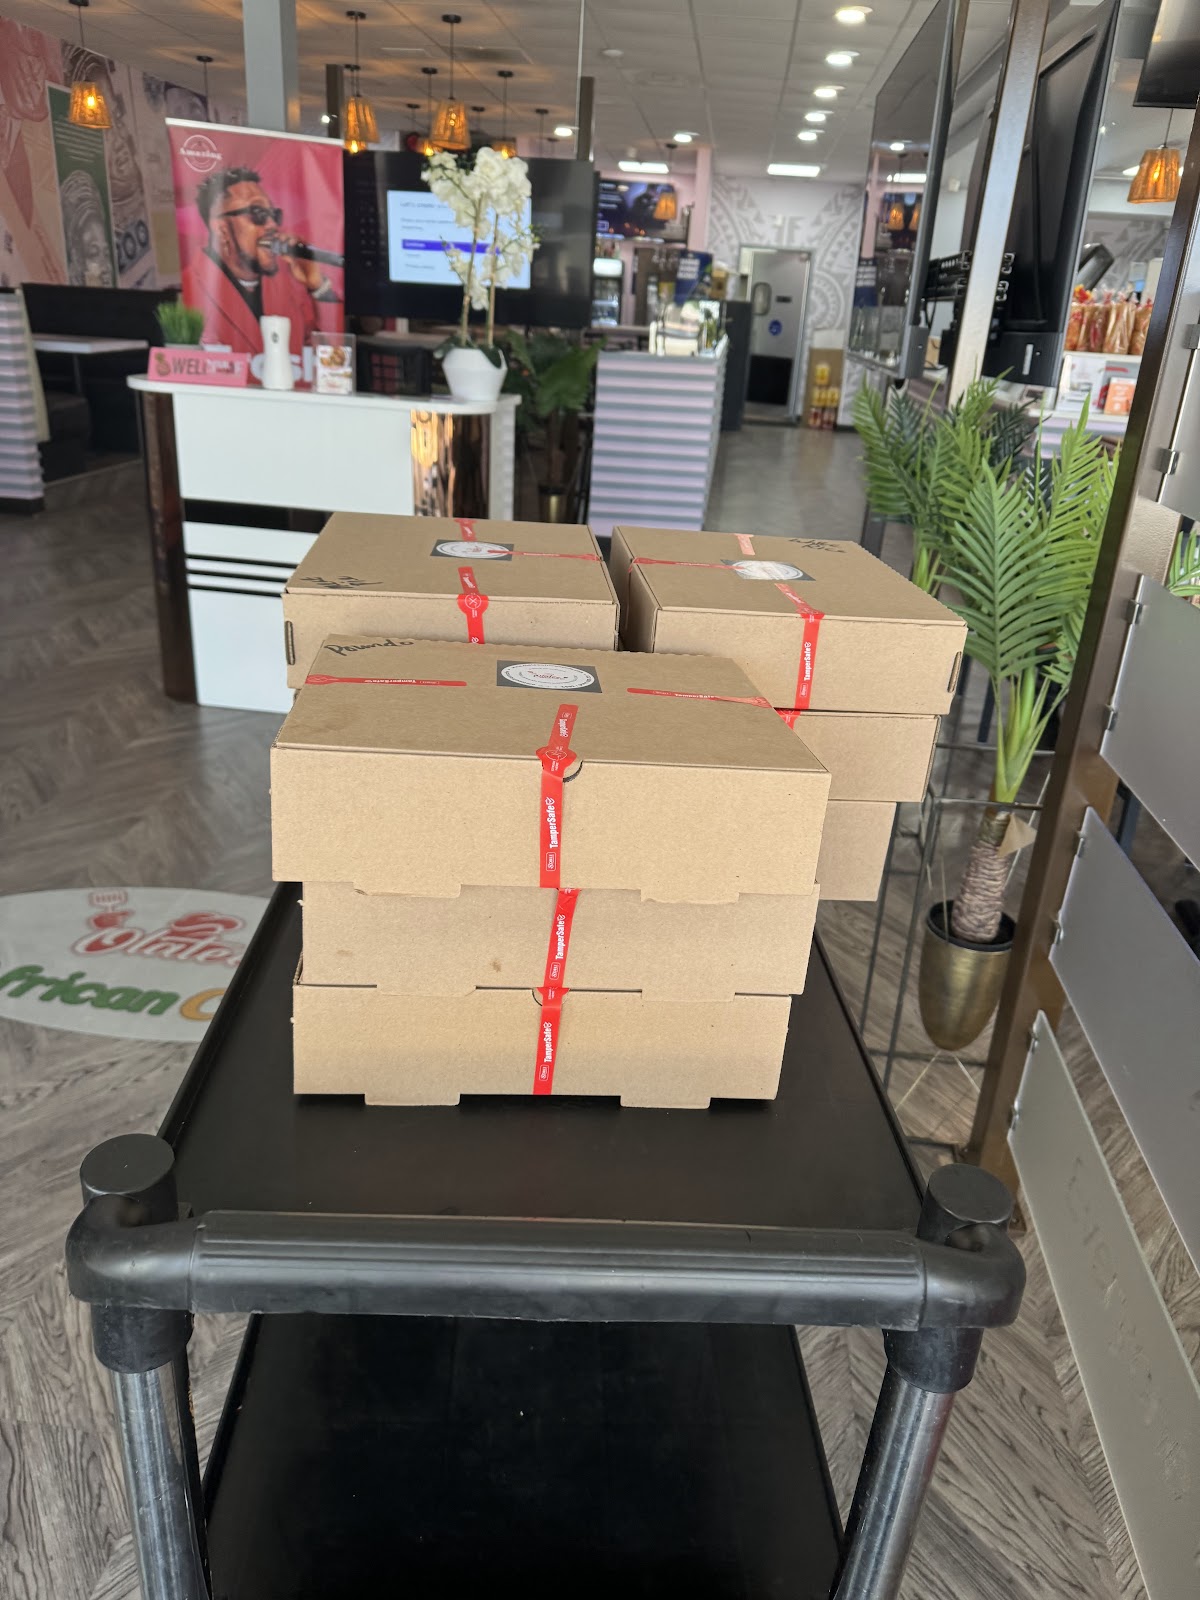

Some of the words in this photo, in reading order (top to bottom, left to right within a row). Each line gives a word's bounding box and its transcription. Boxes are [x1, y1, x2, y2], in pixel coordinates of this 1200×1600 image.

[803, 646, 812, 681] TamperSafe
[546, 804, 559, 849] TamperSafe
[555, 919, 566, 960] TamperSafe
[0, 965, 180, 1015] frican
[543, 1026, 554, 1063] TamperSafe
